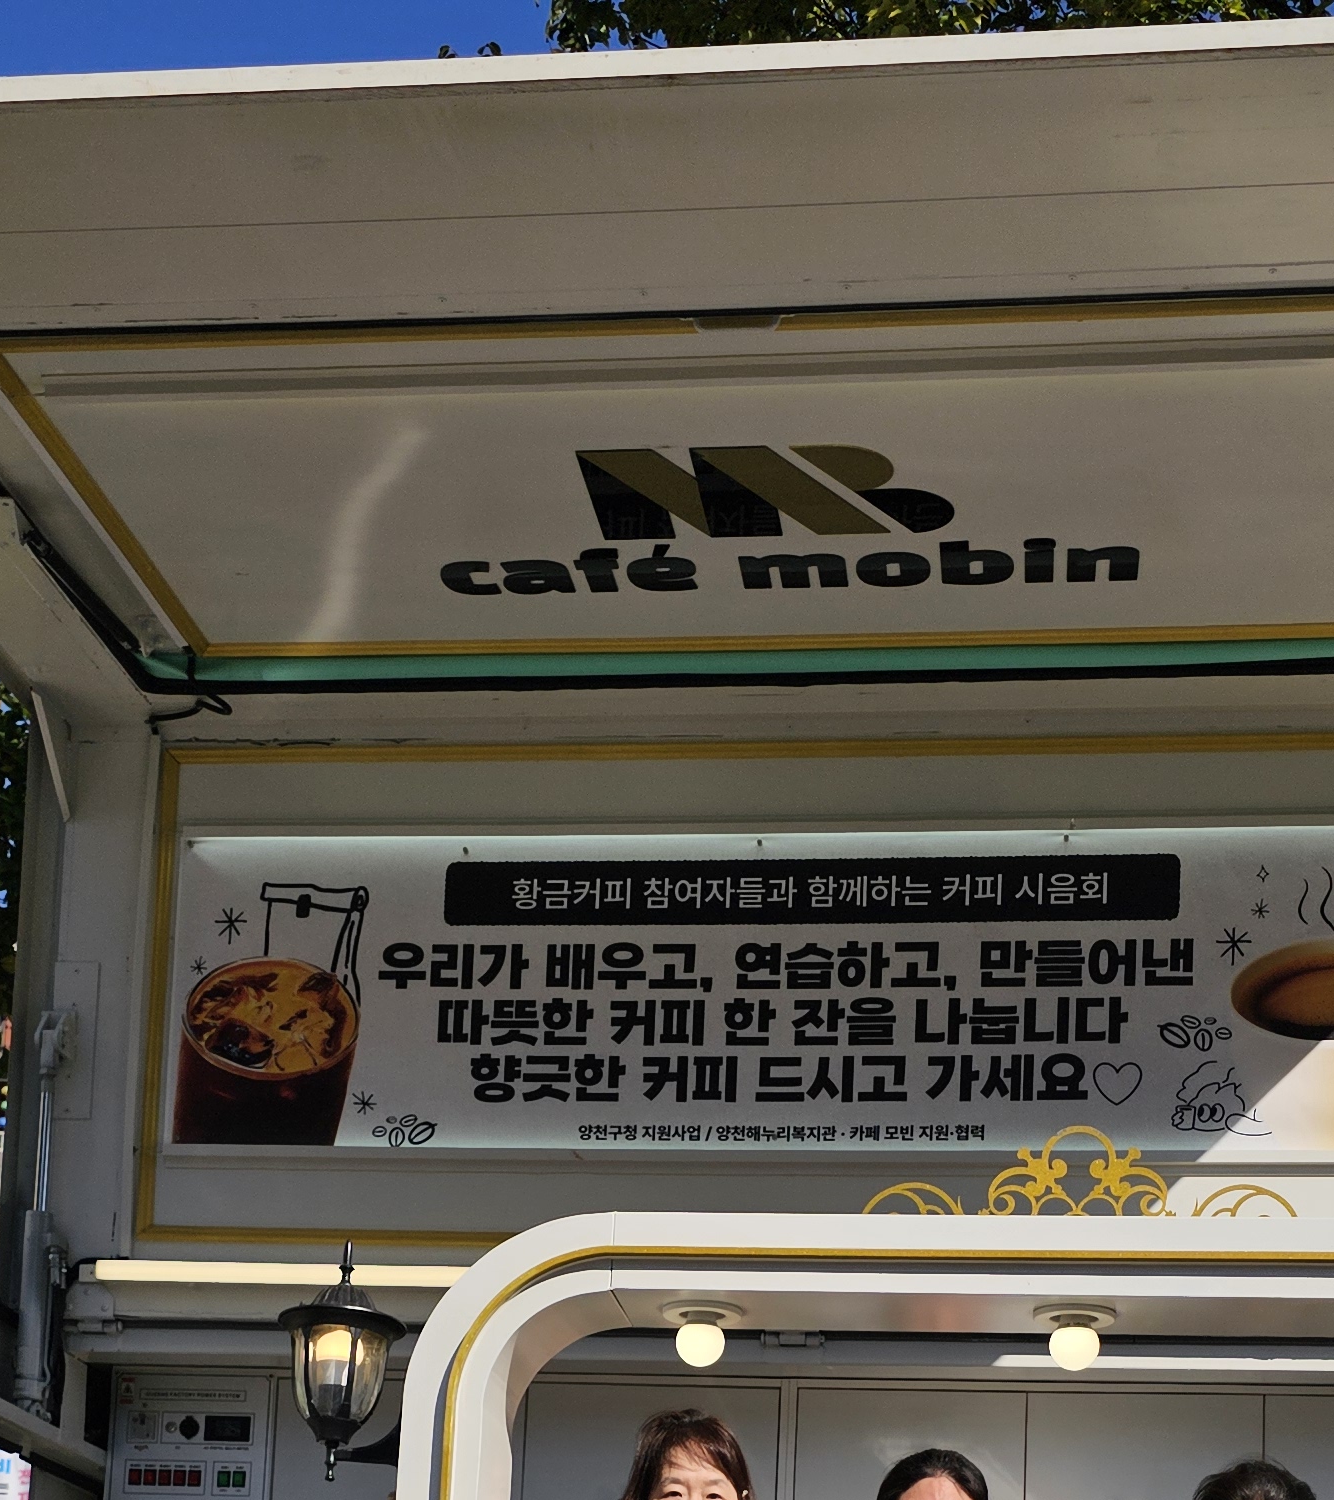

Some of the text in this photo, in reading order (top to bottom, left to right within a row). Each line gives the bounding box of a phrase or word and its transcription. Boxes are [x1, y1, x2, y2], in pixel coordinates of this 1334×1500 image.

[439, 538, 1140, 596] café mobin
[511, 872, 1109, 909] 황금커피 참여자들과 함께하는 커피 시음회
[378, 938, 1194, 993] 우리가 배우고, 연습하고, 만들어낸
[437, 996, 1129, 1046] 따뜻한 커피 한 잔을 나눕니다
[470, 1053, 626, 1103] 향긋한
[642, 1055, 738, 1103] 커피
[755, 1054, 908, 1103] 드시고
[578, 1124, 638, 1141] 양천구청
[641, 1124, 702, 1141] 지원사업
[716, 1124, 837, 1142] 양천해누리복지관
[849, 1124, 880, 1142] 카페
[884, 1124, 915, 1142] 모빈
